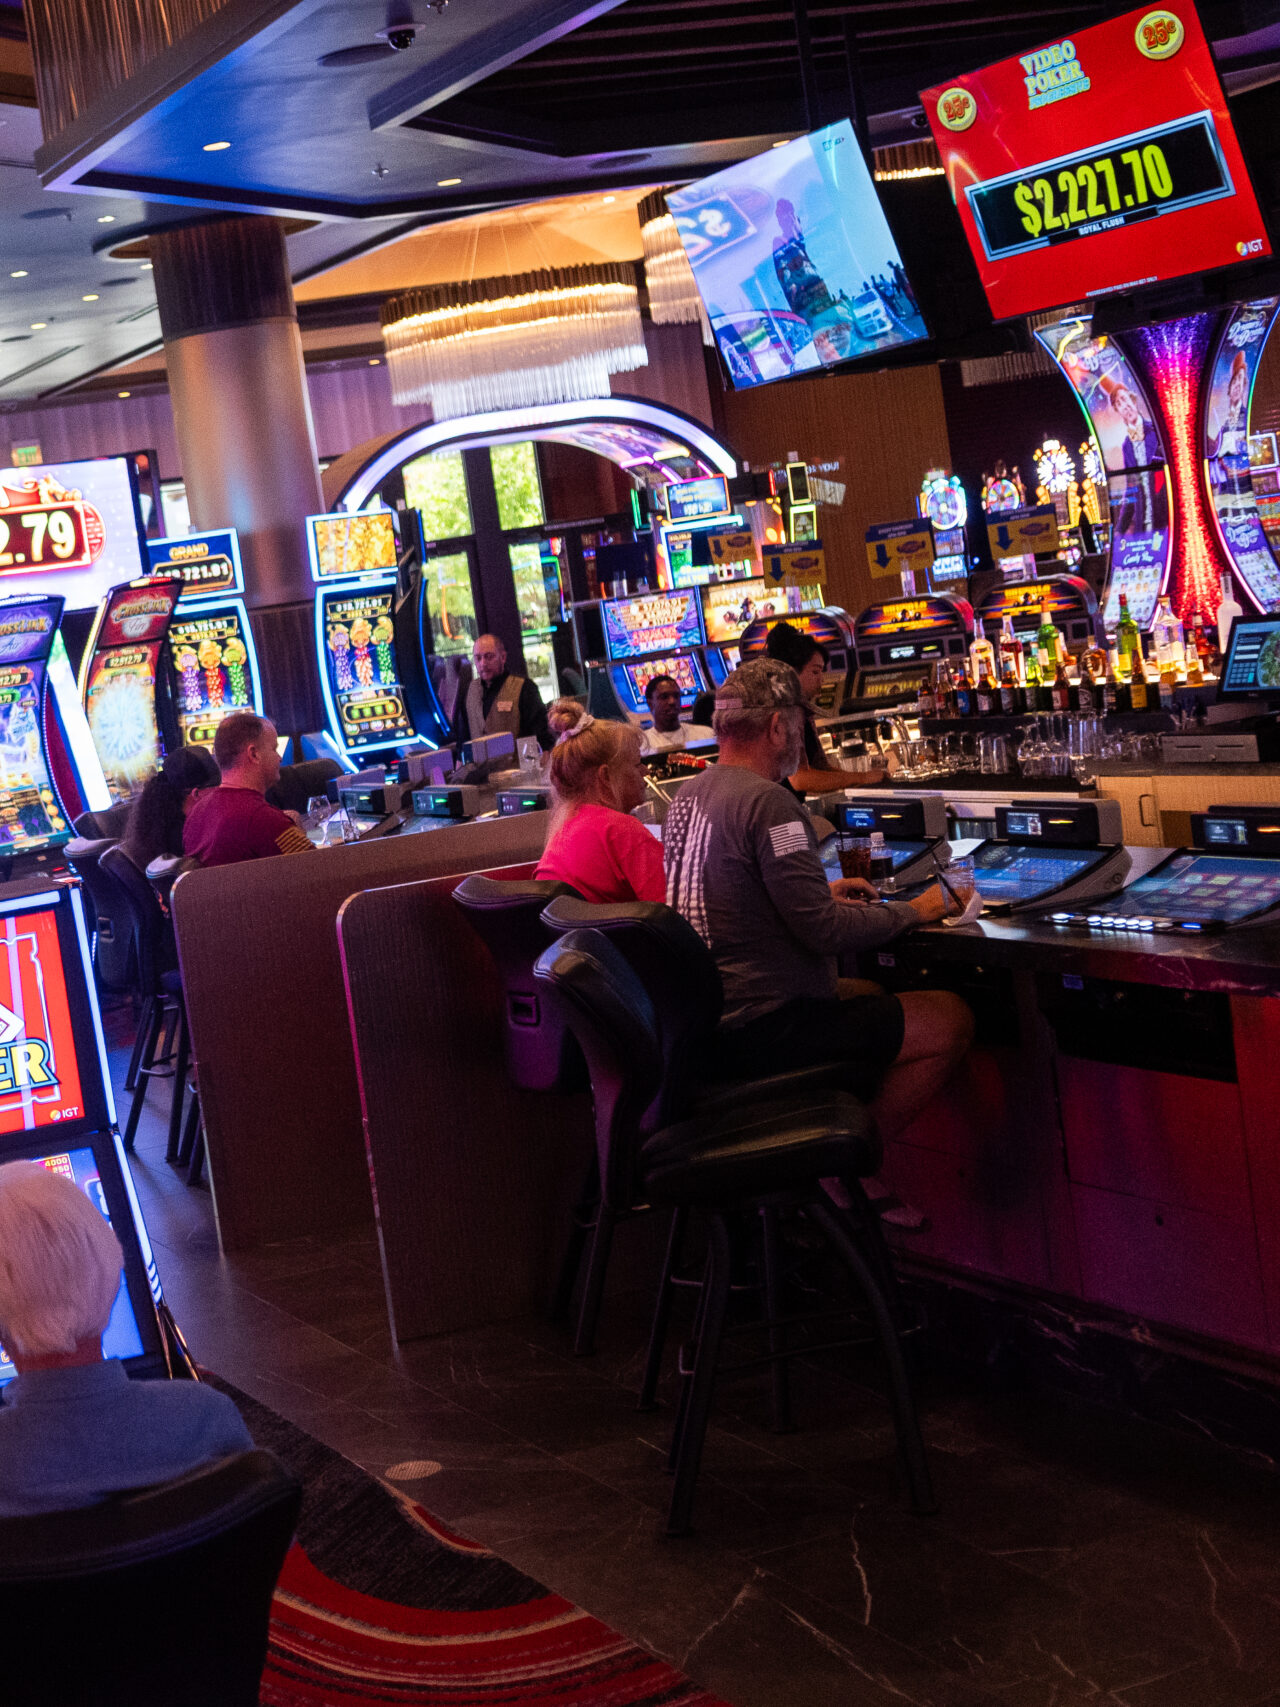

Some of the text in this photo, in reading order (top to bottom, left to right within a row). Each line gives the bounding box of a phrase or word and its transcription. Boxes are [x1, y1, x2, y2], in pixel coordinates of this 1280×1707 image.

[1020, 40, 1077, 76] VIDEO
[1024, 60, 1086, 96] POKER
[1014, 144, 1174, 238] $2,227.70
[1078, 217, 1125, 236] ROYAL FLUSH
[1248, 240, 1263, 253] IGT
[169, 543, 209, 560] GRAND
[61, 1106, 80, 1119] IGT
[44, 1157, 68, 1167] 4000
